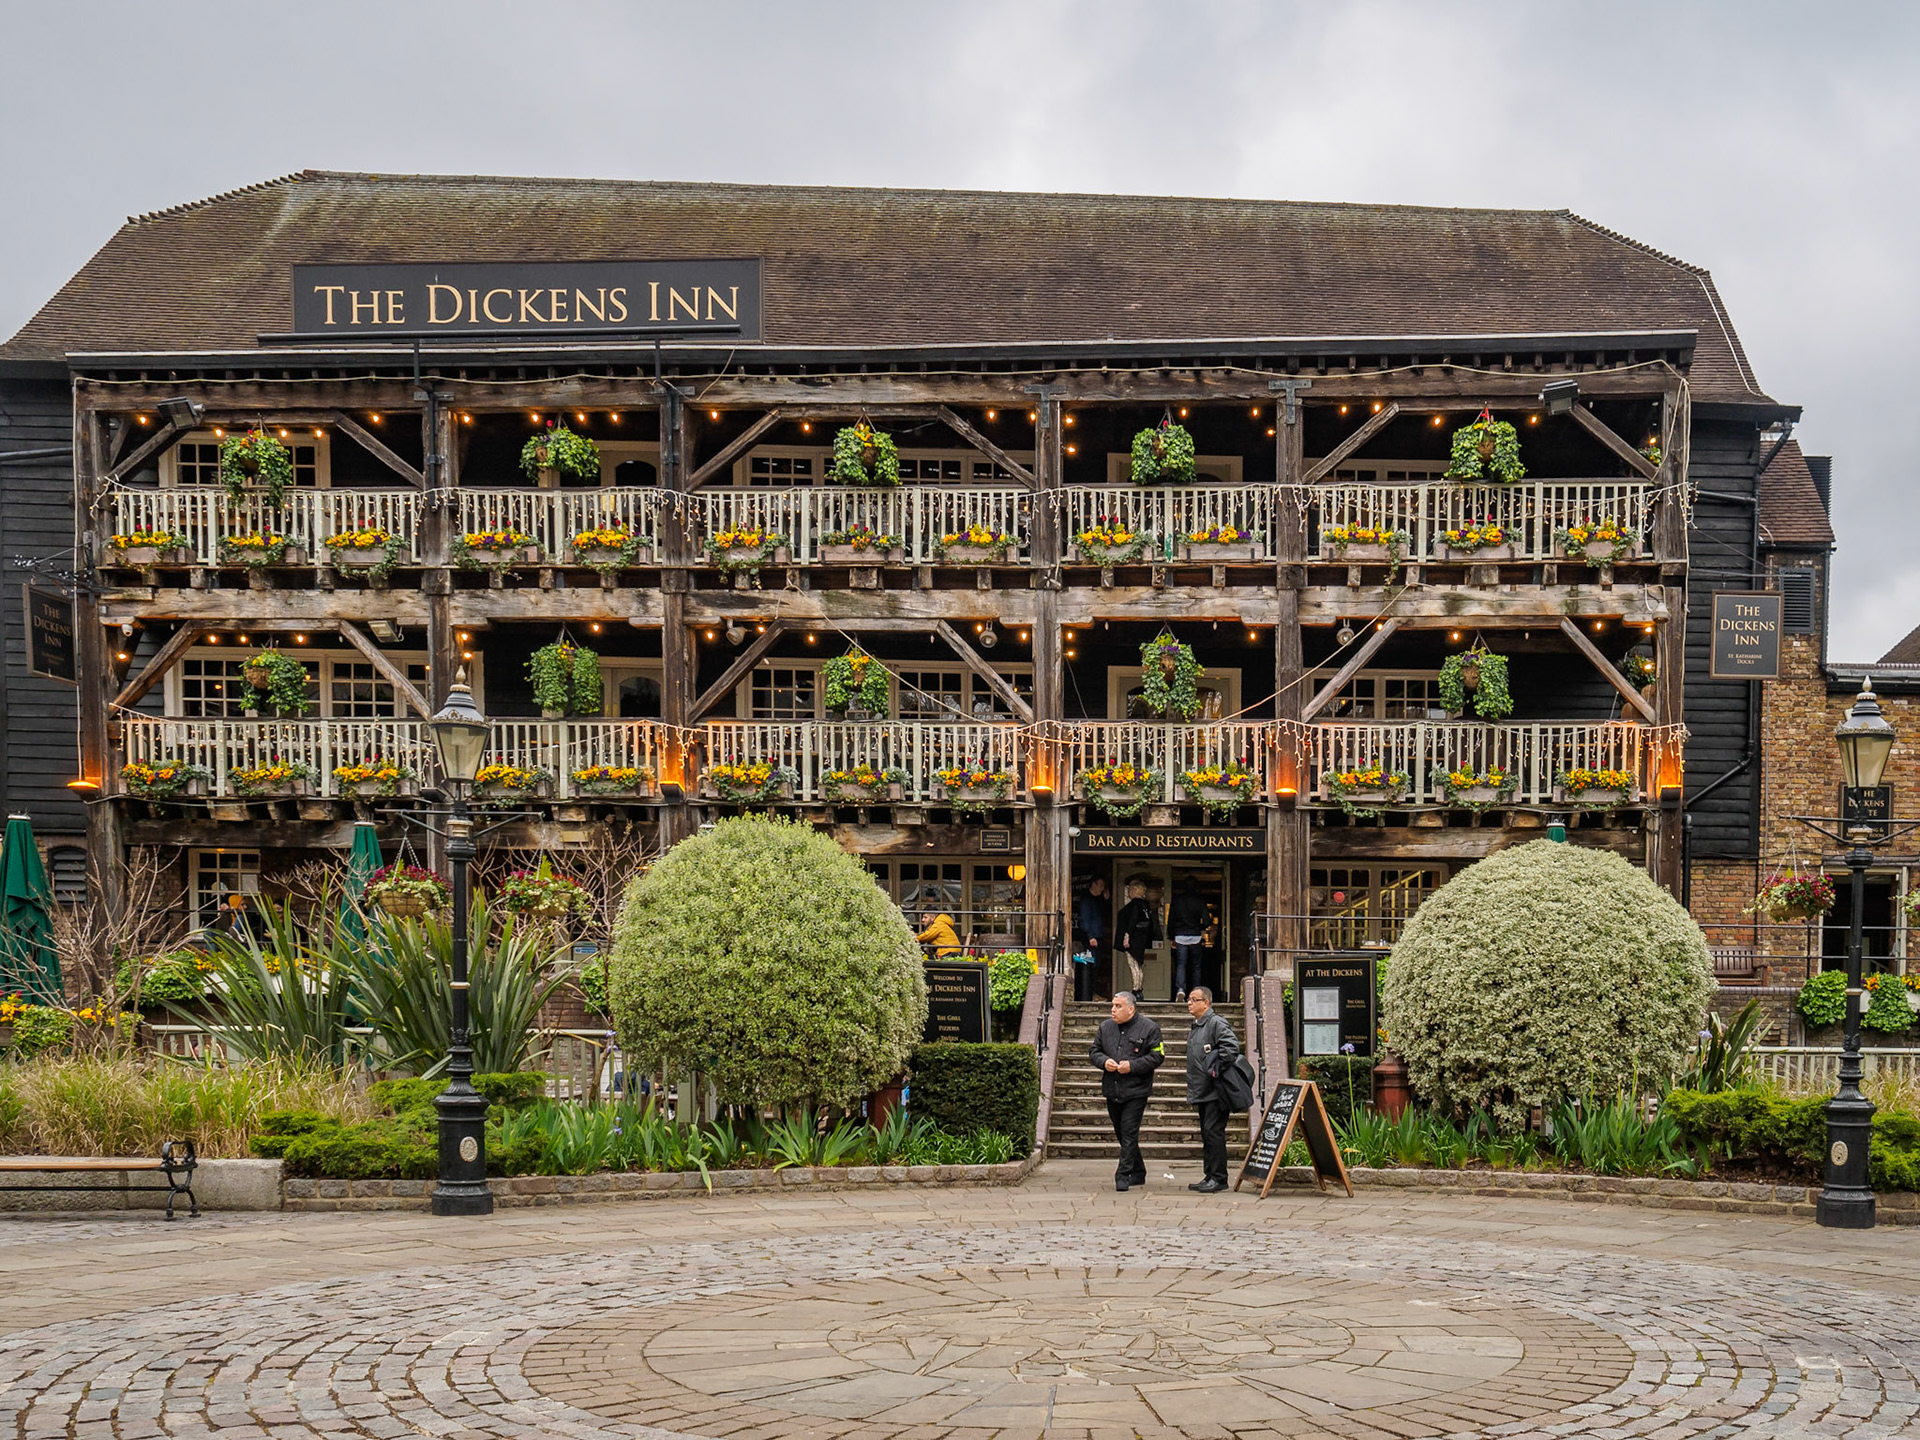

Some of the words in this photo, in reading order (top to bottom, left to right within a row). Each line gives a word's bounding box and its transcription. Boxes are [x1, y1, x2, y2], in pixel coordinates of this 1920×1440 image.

[313, 285, 405, 325] THE
[425, 284, 628, 324] DICKENS
[648, 281, 739, 322] INN
[43, 603, 60, 619] THE
[1735, 604, 1760, 616] THE
[33, 615, 71, 636] DICKENS
[1720, 618, 1775, 631] DICKENS
[44, 633, 62, 648] INN
[1734, 633, 1759, 646] INN
[1088, 834, 1116, 847] BAR
[1119, 836, 1151, 847] AND
[1156, 834, 1253, 848] RESTAURANTS
[1305, 969, 1315, 977] AT
[1316, 968, 1330, 977] THE
[1332, 968, 1363, 977] DICKENS
[963, 985, 976, 993] INN
